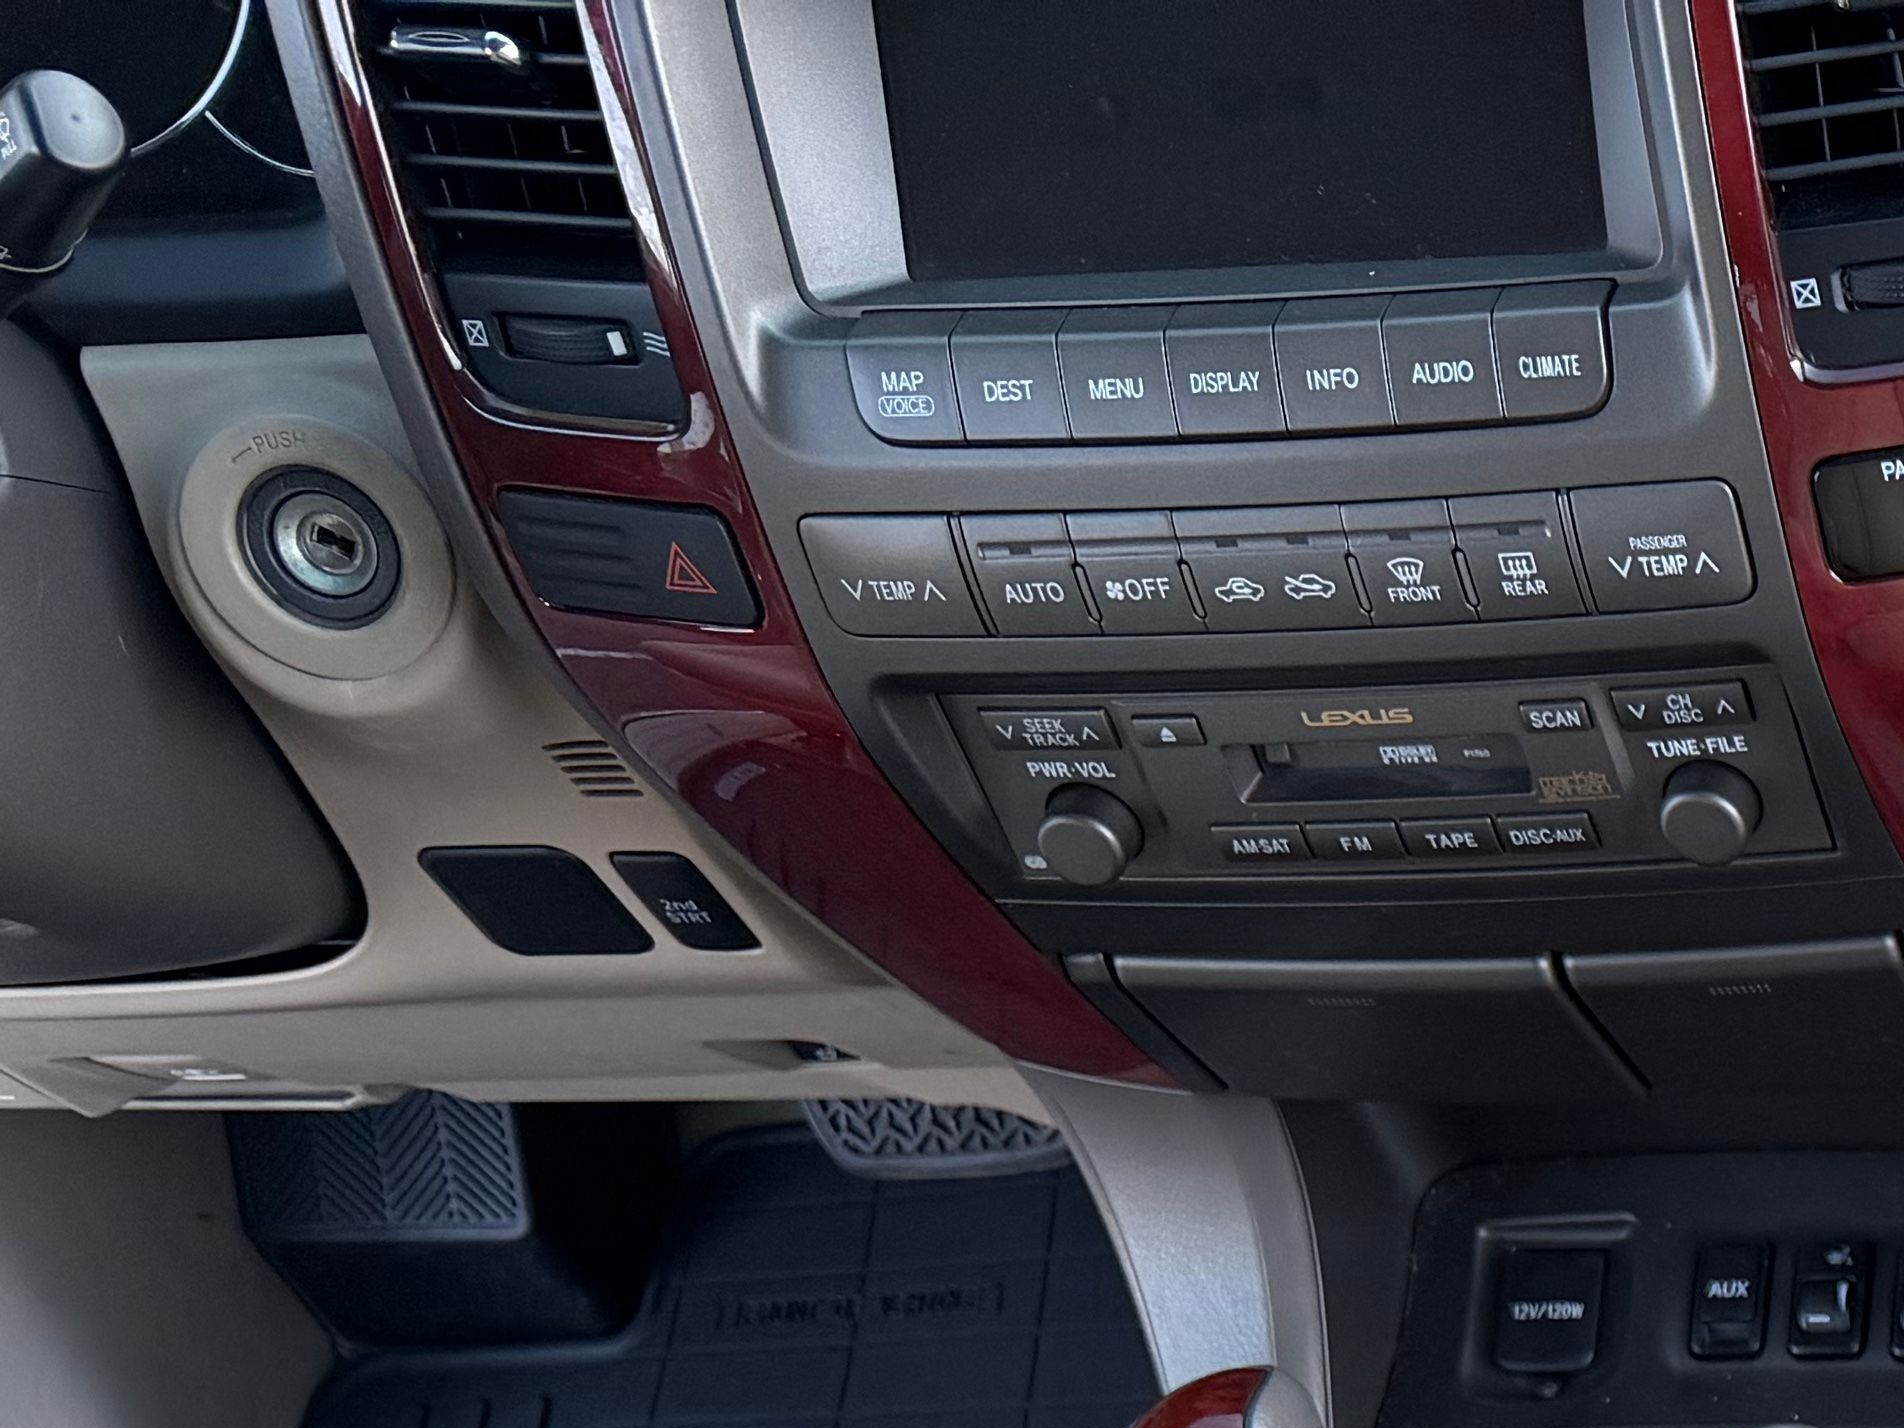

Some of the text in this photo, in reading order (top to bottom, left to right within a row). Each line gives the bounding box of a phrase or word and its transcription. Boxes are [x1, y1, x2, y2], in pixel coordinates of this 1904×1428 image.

[1412, 360, 1474, 384] AUDIO
[1518, 354, 1581, 378] CLIMATE
[881, 371, 924, 392] MAP
[1189, 370, 1259, 395] DISPLAY
[1306, 367, 1359, 390] INFO
[983, 380, 1033, 402] DEST
[1088, 377, 1144, 400] MENU
[883, 397, 929, 414] VOICE
[252, 430, 306, 453] PUSH
[1629, 534, 1687, 550] PASSENGER
[1638, 556, 1688, 577] TEMP
[868, 580, 915, 601] TEMP
[1005, 582, 1065, 604] AUTO
[1125, 577, 1169, 600] OFF
[1387, 585, 1441, 602] FRONT
[1502, 580, 1548, 596] REAR
[1667, 693, 1693, 710] CH
[1023, 718, 1065, 733] SEEK
[1300, 708, 1414, 727] LEXUS
[1529, 710, 1581, 728] SCAN
[1663, 709, 1704, 725] DISC
[1022, 733, 1079, 747] TRACK
[1339, 836, 1373, 852] FM
[1425, 832, 1478, 849] TAPE
[660, 898, 698, 911] 2nd
[1707, 1279, 1750, 1299] AUX
[1511, 1302, 1585, 1321] 12V/120W
